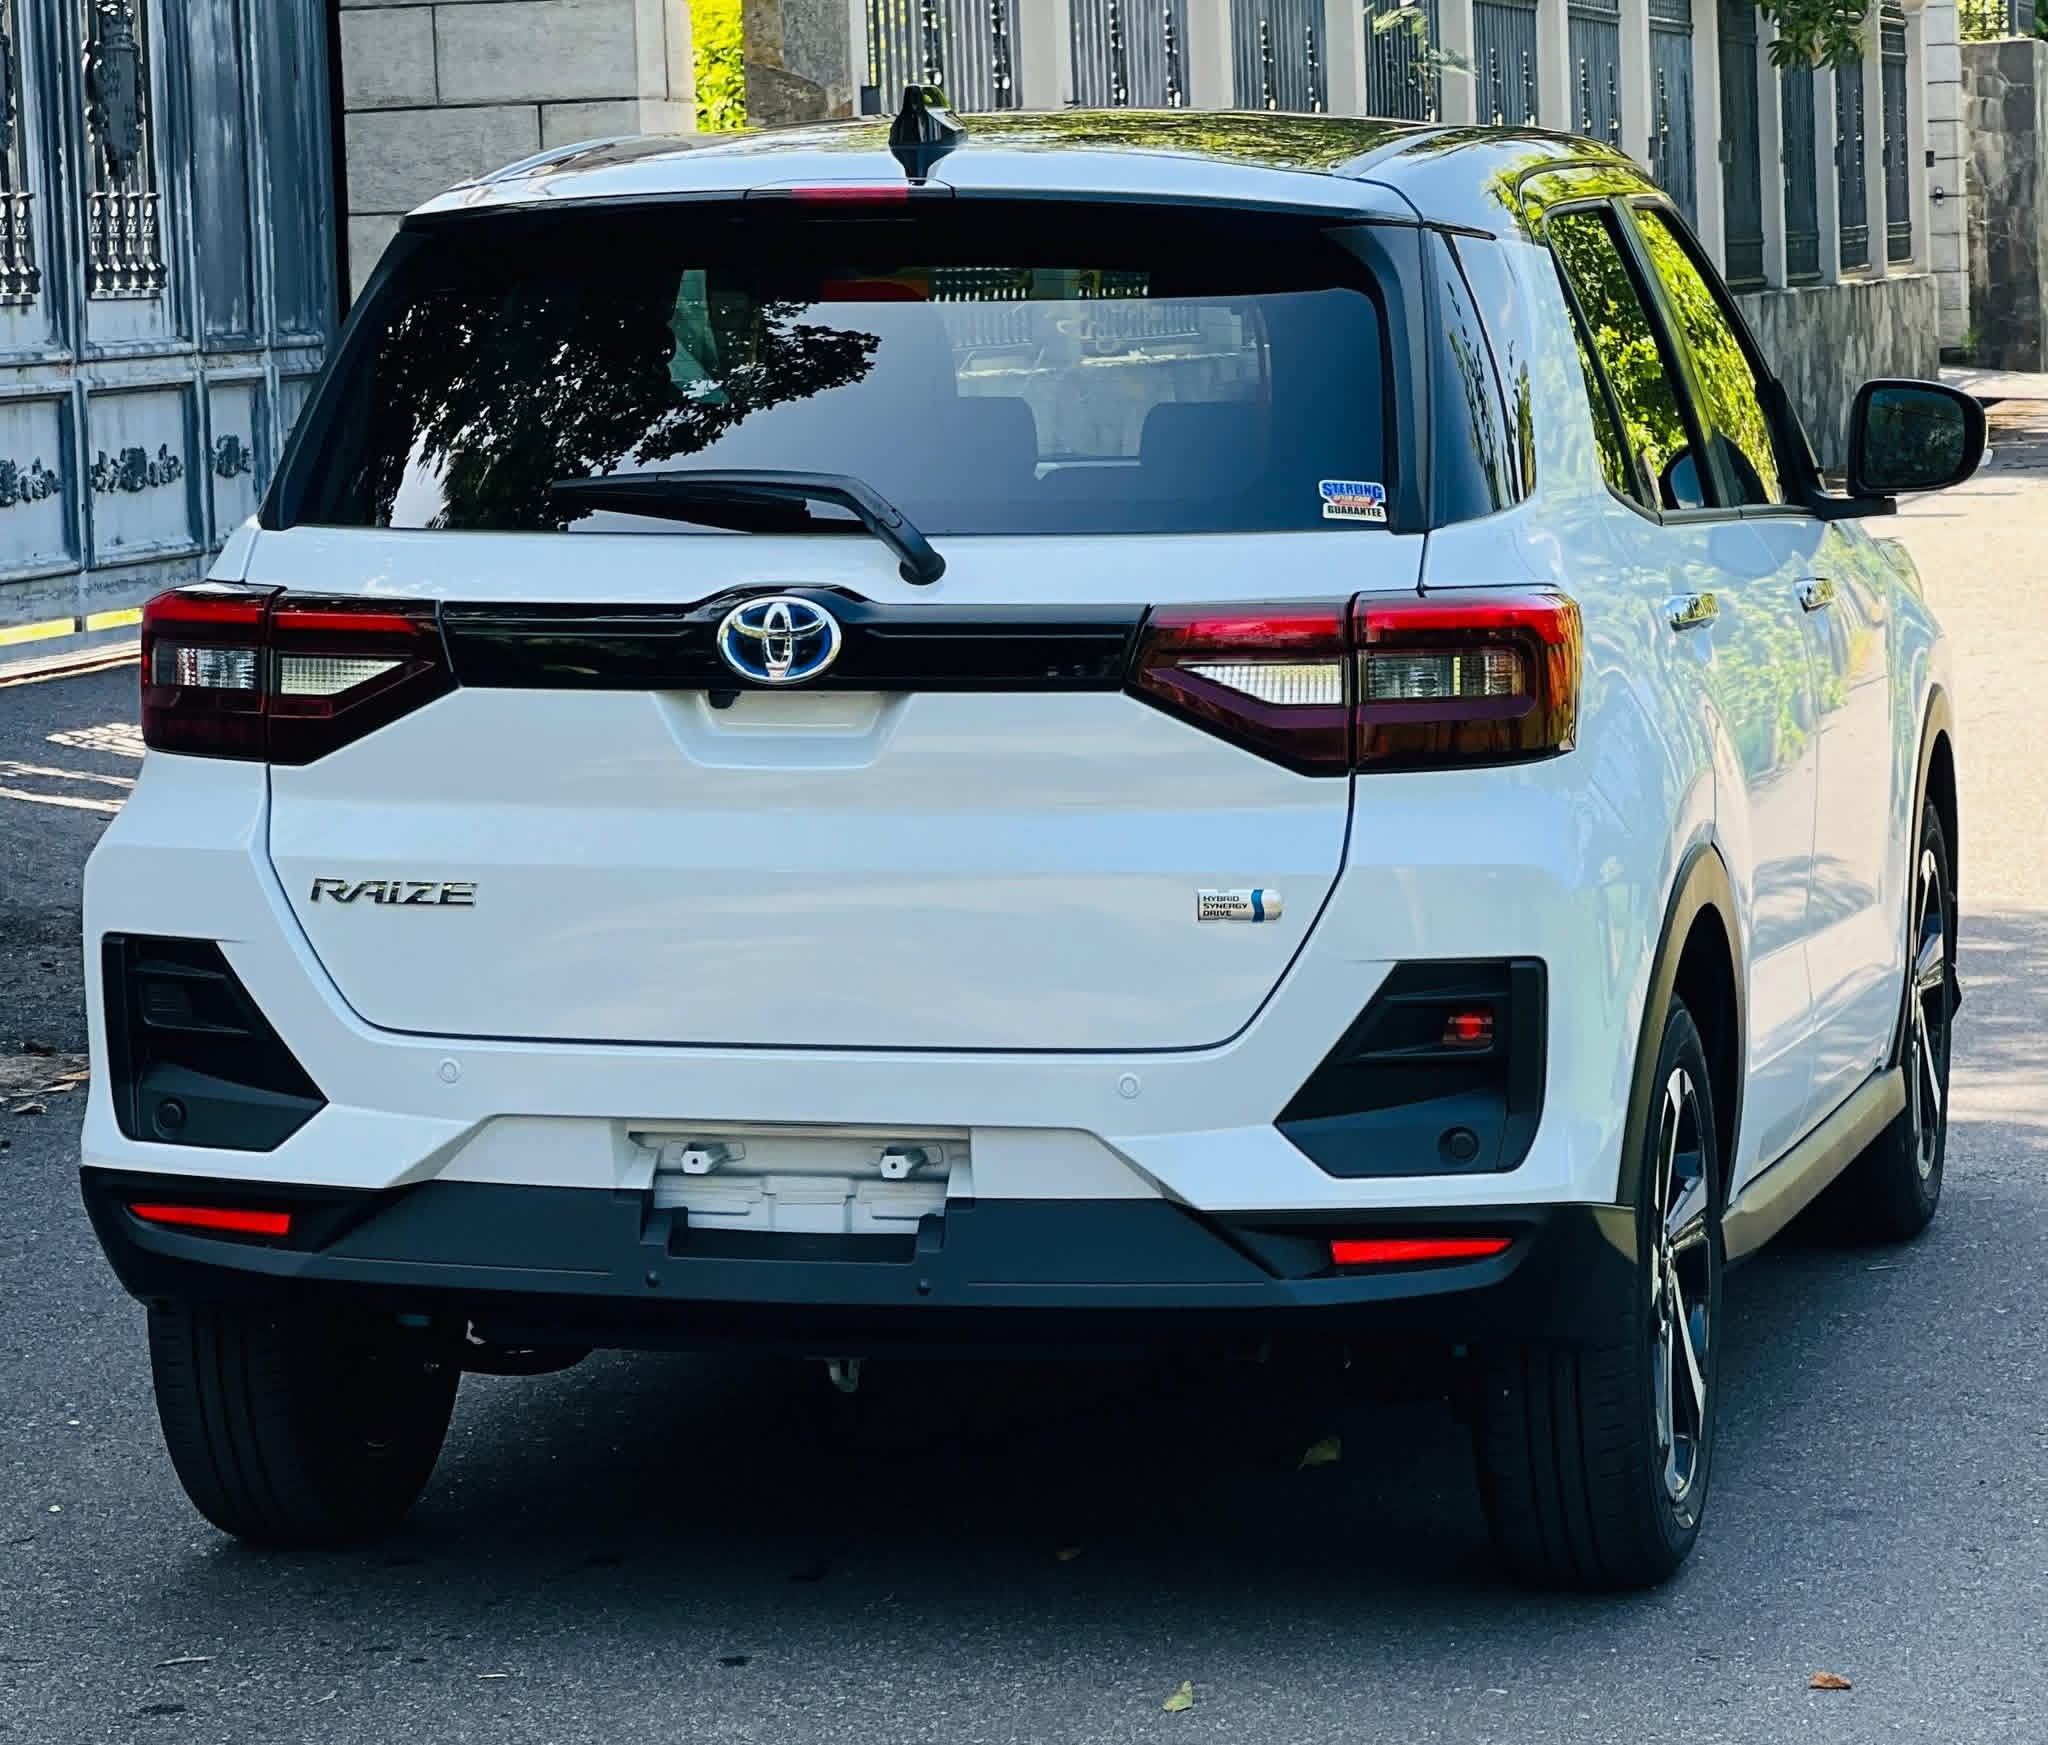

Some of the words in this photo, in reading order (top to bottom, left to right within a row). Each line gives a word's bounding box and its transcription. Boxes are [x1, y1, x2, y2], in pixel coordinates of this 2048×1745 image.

[1322, 482, 1383, 500] STERLING
[1327, 505, 1383, 517] GUARANTEE
[309, 877, 479, 905] RAIZE
